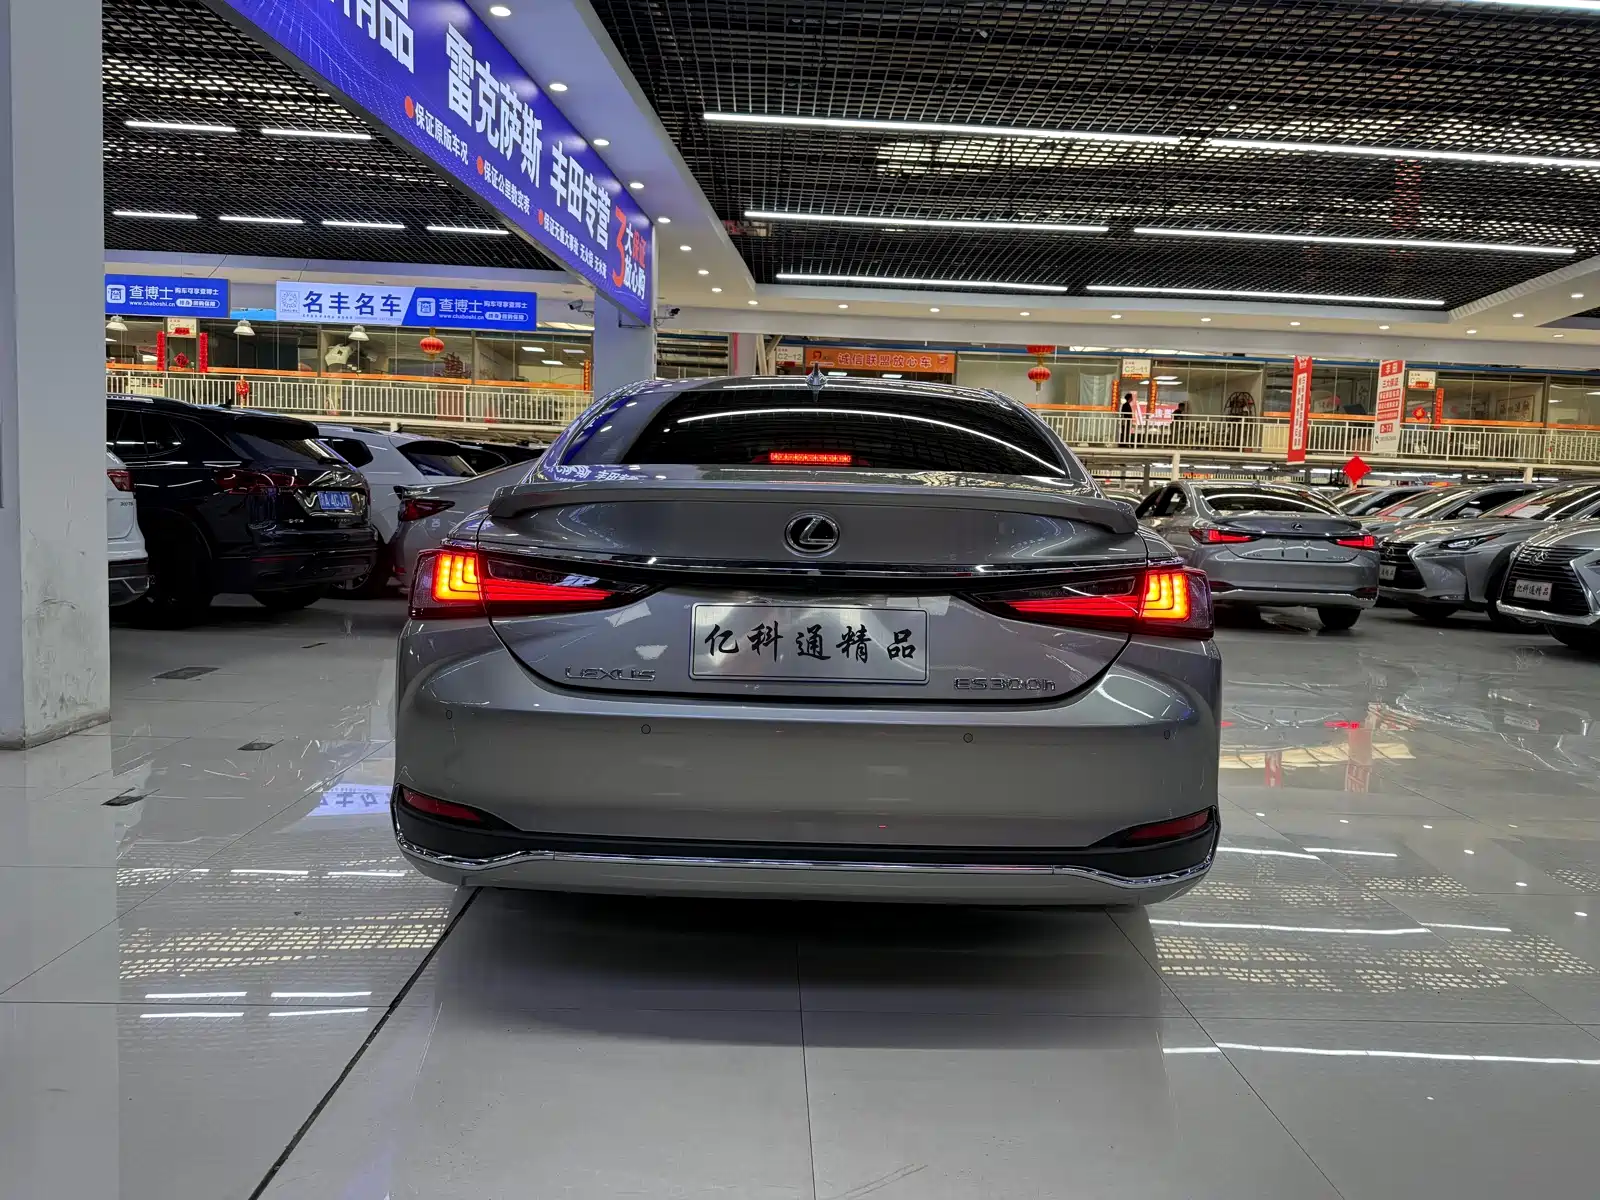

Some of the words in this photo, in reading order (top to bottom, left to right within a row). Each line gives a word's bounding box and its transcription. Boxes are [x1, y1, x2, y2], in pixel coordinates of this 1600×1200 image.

[446, 22, 543, 188] 雷克萨斯
[549, 141, 612, 250] 丰田专营
[612, 205, 626, 288] 3
[129, 285, 173, 300] 查博士
[129, 300, 176, 308] www.chaboshi.cn
[303, 290, 402, 317] 名丰名车
[439, 298, 483, 314] 查博士
[439, 313, 485, 321] www.chaboshi.cn
[778, 352, 802, 361] C2-12
[838, 352, 933, 368] 诚信联盟放心车
[1124, 365, 1148, 373] C2-11
[705, 620, 916, 663] 亿科通精品
[564, 664, 656, 682] LEXUS
[954, 677, 1056, 691] ES300h
